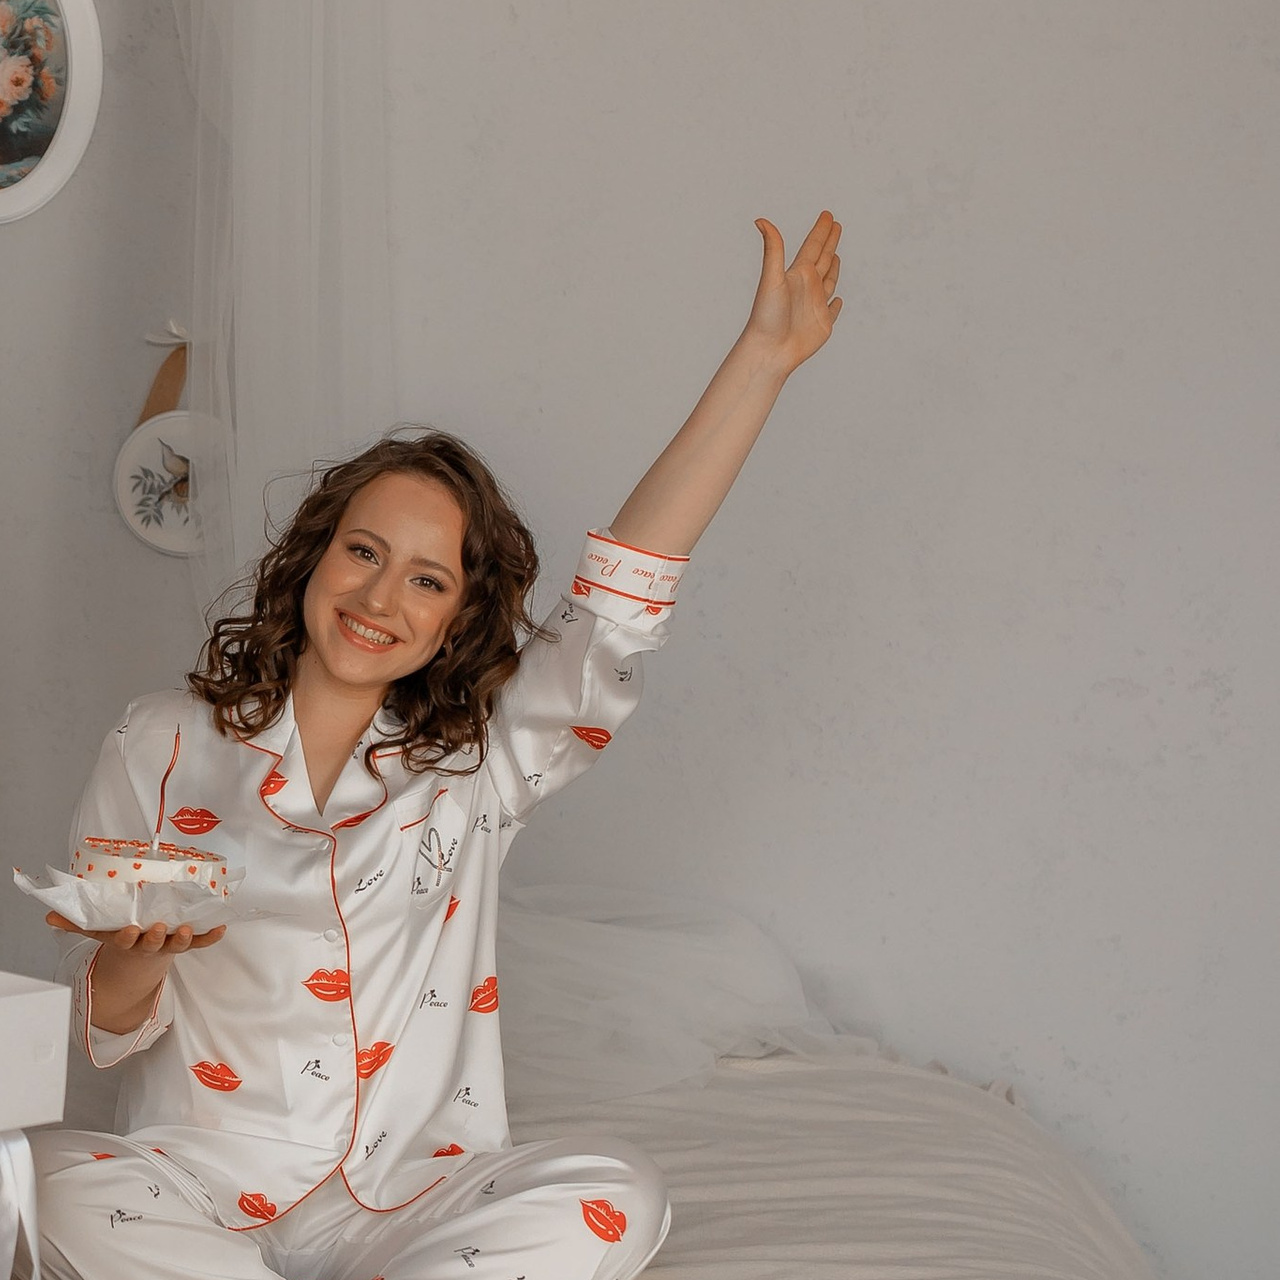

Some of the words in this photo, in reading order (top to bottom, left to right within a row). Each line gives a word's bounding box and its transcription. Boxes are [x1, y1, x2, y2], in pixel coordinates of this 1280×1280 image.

[587, 552, 622, 577] Peace
[561, 602, 579, 624] Pea
[354, 869, 385, 894] Love
[420, 989, 449, 1010] Peace
[300, 1059, 330, 1082] Peace
[453, 1086, 479, 1108] Peace
[365, 1131, 388, 1160] Love
